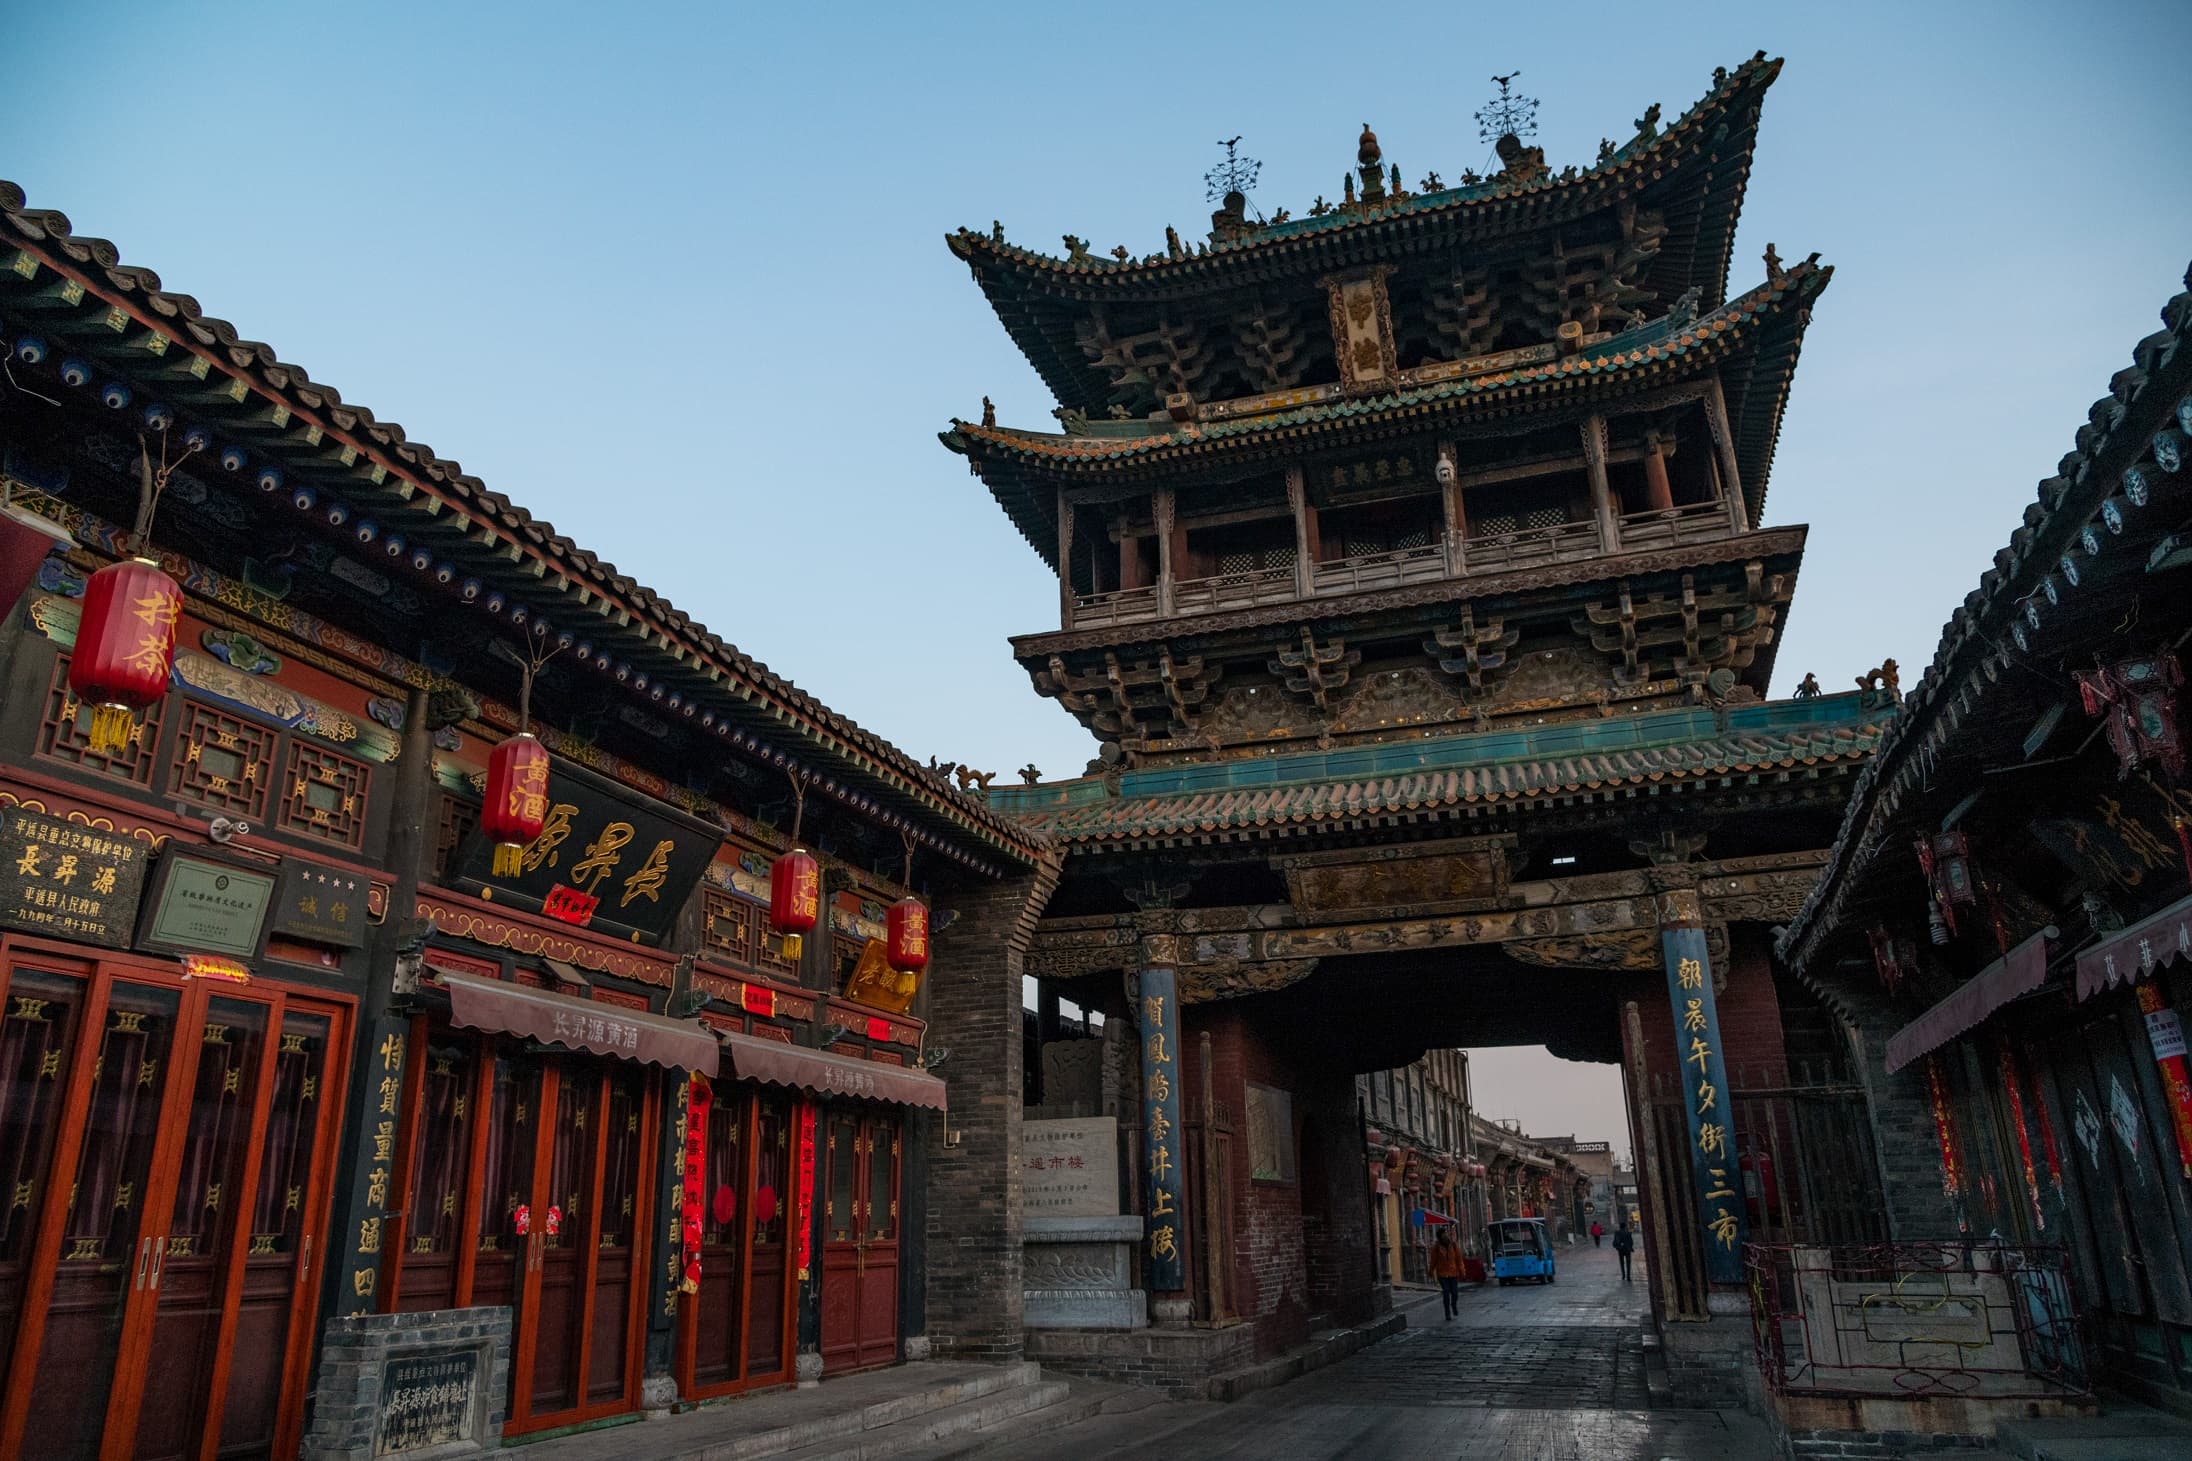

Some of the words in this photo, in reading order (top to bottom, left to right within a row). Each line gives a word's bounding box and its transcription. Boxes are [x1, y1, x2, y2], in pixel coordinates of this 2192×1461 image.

[509, 756, 549, 823] 黄酒
[24, 886, 101, 917] 平遥县人民政府
[351, 1033, 405, 1318] 恃質量商通四
[1023, 1156, 1086, 1170] 遥市楼
